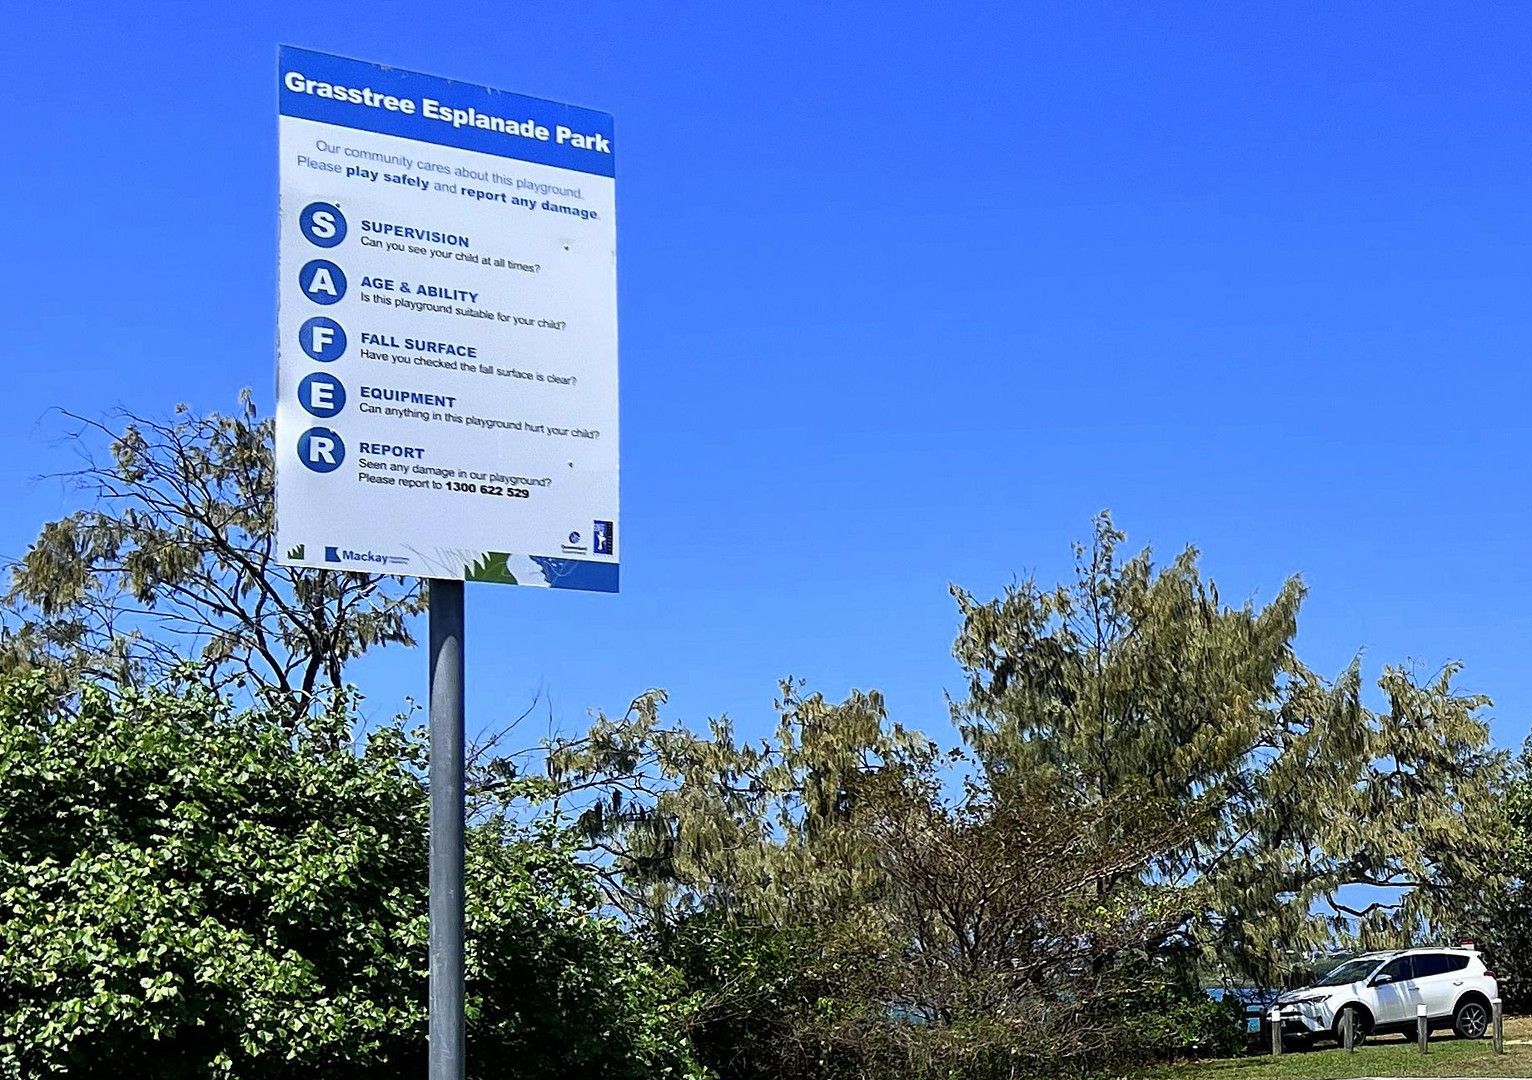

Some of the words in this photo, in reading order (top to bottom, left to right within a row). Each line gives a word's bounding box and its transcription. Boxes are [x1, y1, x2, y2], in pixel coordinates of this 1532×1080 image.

[285, 72, 416, 114] Grasstree
[423, 98, 550, 141] Esplanade
[556, 125, 611, 154] Park
[316, 140, 341, 154] Our
[344, 147, 413, 170] community
[417, 159, 451, 175] cares
[454, 166, 489, 181] about
[492, 172, 513, 186] this
[297, 155, 342, 173] Please
[346, 165, 378, 182] play
[384, 173, 429, 190] safely
[433, 182, 457, 194] and
[461, 187, 506, 203] report
[511, 195, 537, 210] any
[311, 210, 336, 238] S
[361, 220, 469, 247] SUPERVISION
[360, 236, 383, 248] Can
[386, 241, 405, 252] you
[408, 245, 427, 255] see
[430, 248, 453, 259] your
[455, 251, 479, 263] child
[481, 257, 491, 266] at
[494, 258, 505, 267] all
[507, 260, 541, 273] times?
[309, 268, 338, 296] A
[361, 276, 395, 291] AGE
[399, 281, 411, 293] &
[416, 284, 479, 303] ABILITY
[360, 291, 371, 302] Is
[373, 293, 392, 305] this
[394, 298, 453, 314] playground
[455, 306, 494, 320] suitable
[497, 312, 511, 322] for
[513, 315, 536, 326] your
[537, 319, 566, 330] child?
[313, 326, 334, 352] F
[361, 332, 400, 348] FALL
[404, 338, 477, 358] SURFACE
[360, 348, 389, 361] Have
[391, 354, 411, 364] you
[413, 356, 457, 370] checked
[460, 361, 477, 372] the
[479, 363, 494, 374] fall
[496, 367, 534, 380] surface
[536, 371, 544, 381] is
[546, 373, 577, 386] clear?
[311, 381, 334, 409] E
[360, 386, 456, 408] EQUIPMENT
[359, 402, 382, 414] Can
[384, 406, 430, 421] anything
[432, 411, 442, 421] in
[444, 413, 463, 423] this
[465, 416, 522, 430] playground
[524, 421, 545, 433] hurt
[546, 426, 569, 436] your
[570, 428, 600, 440] child?
[310, 436, 336, 464] R
[359, 442, 425, 459] REPORT
[358, 458, 387, 470] Seen
[390, 463, 410, 474] any
[412, 464, 455, 478] damage
[457, 468, 467, 478] in
[469, 470, 487, 480] our
[489, 473, 552, 487] playground?
[358, 472, 395, 485] Please
[398, 477, 430, 489] report
[432, 480, 443, 490] to
[445, 481, 476, 493] 1300
[480, 485, 503, 496] 622
[506, 487, 530, 498] 529
[342, 550, 389, 565] Mackay
